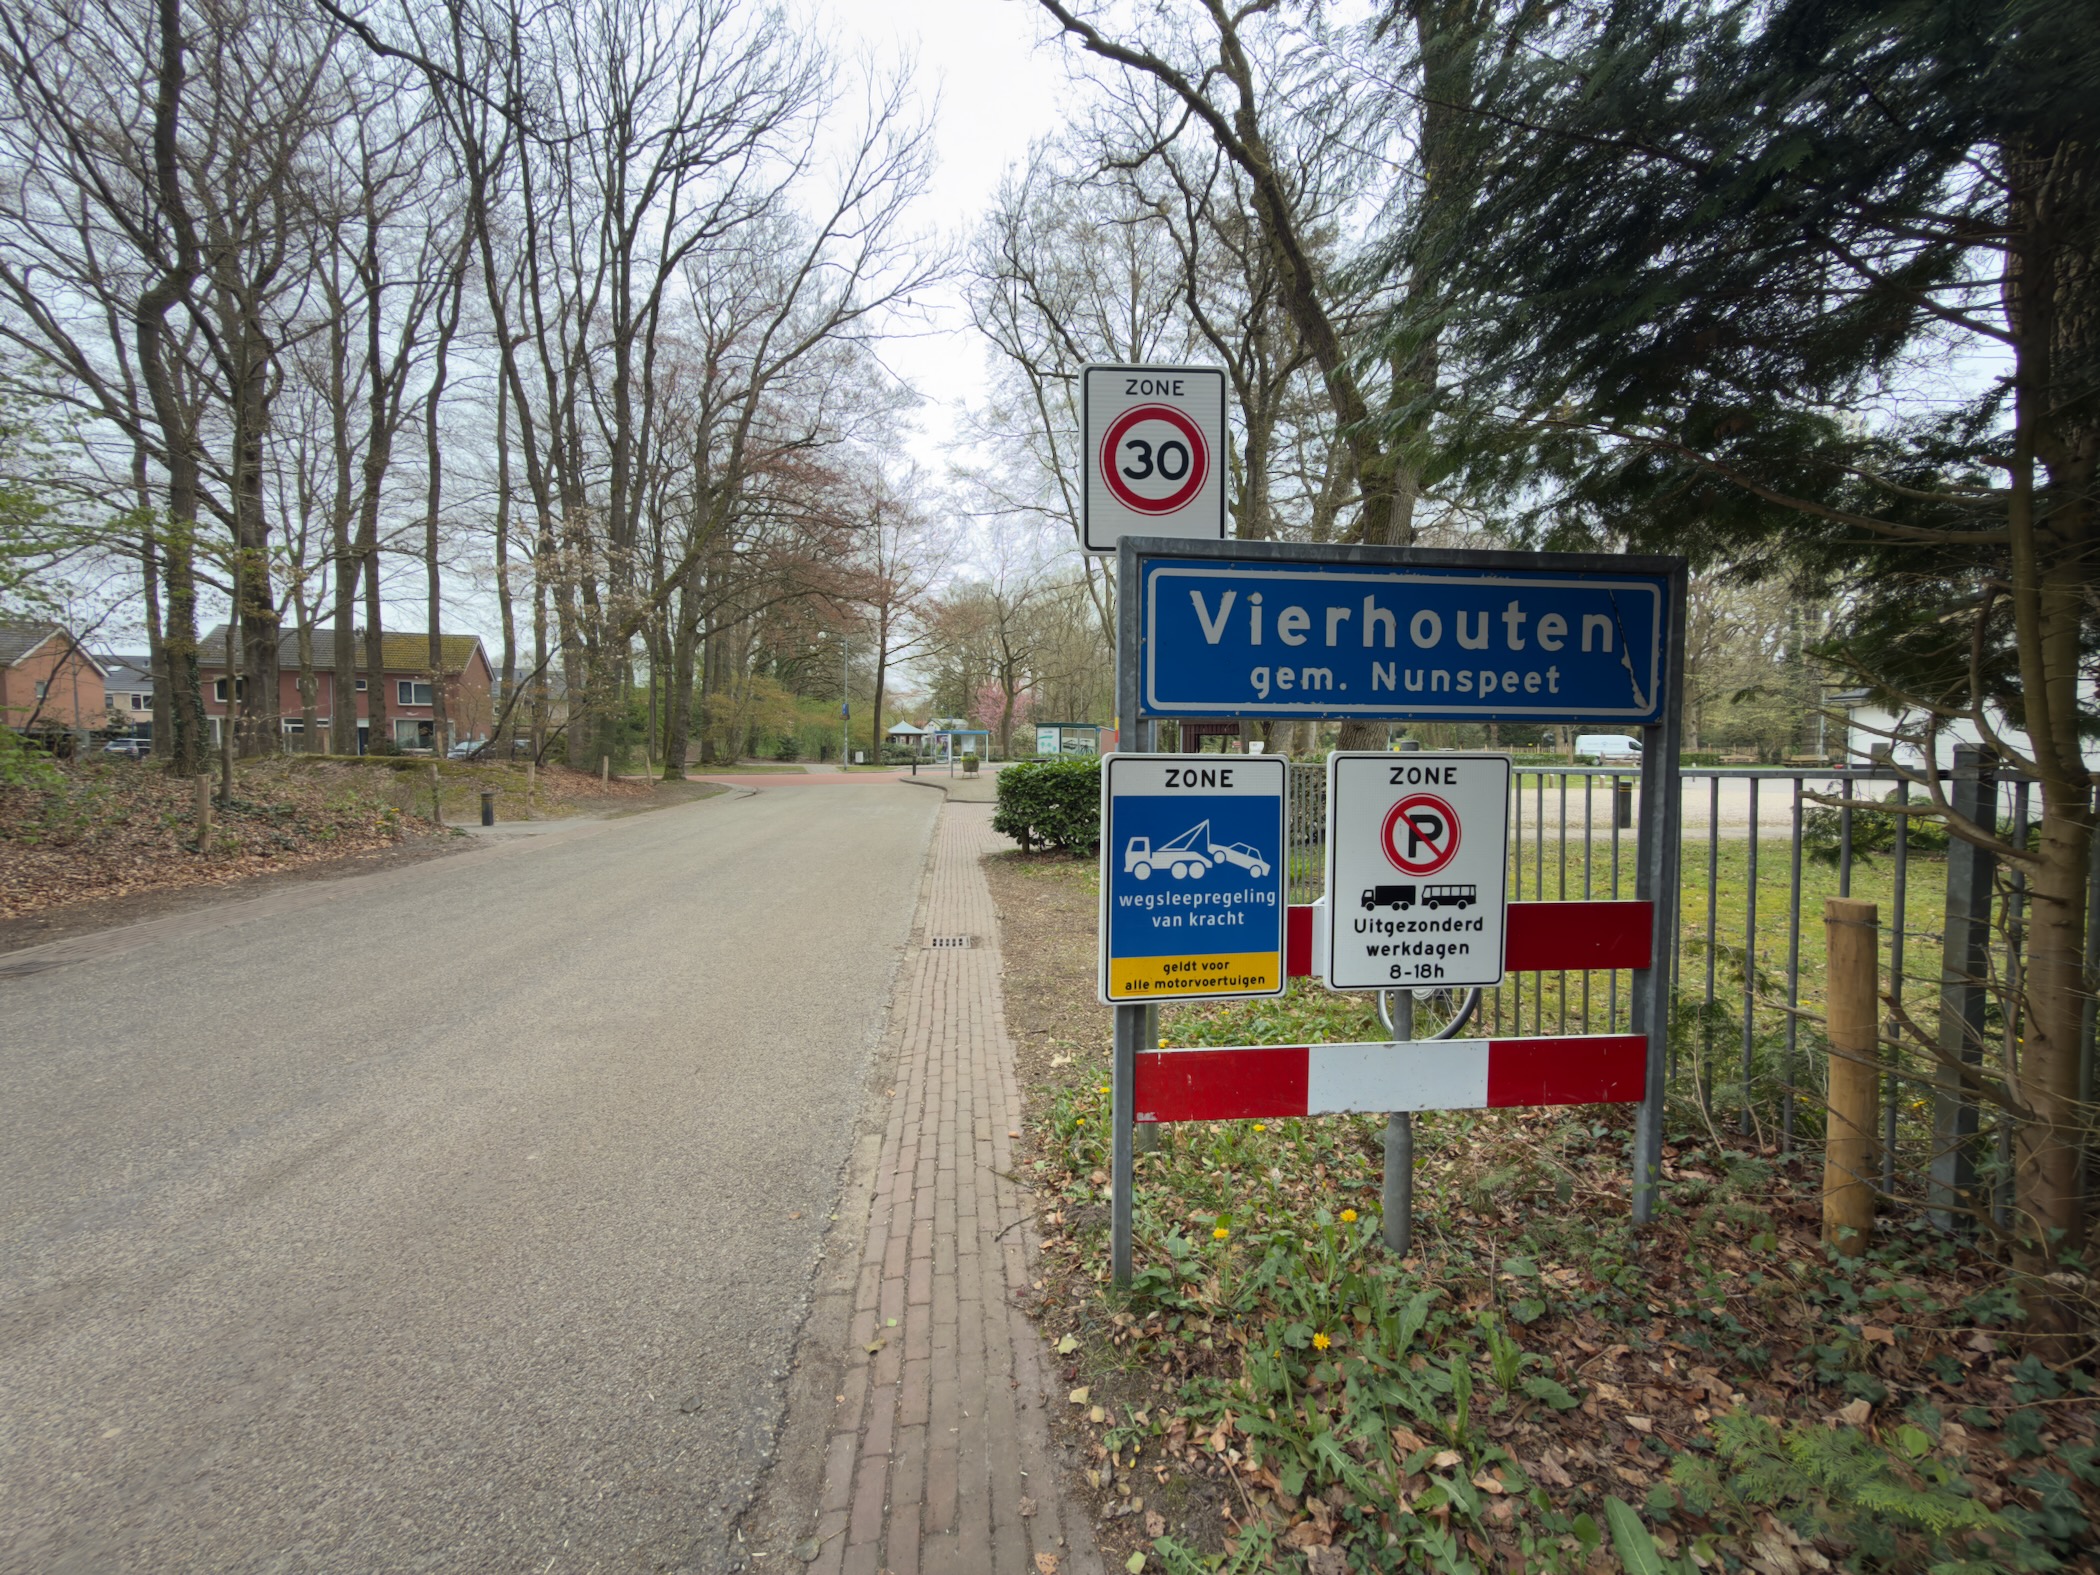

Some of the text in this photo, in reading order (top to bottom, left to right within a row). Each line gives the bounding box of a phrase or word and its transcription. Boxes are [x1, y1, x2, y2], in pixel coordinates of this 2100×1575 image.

[1125, 379, 1185, 397] ZONE
[1122, 439, 1190, 481] 30
[1189, 589, 1613, 653] Vierhouten
[1250, 661, 1560, 700] gem. Nunspeet
[1165, 768, 1234, 788] ZONE
[1389, 766, 1458, 785] ZONE
[1408, 814, 1443, 858] P
[1119, 888, 1276, 911] wegsleepregeling
[1152, 910, 1245, 928] van kracht
[1354, 916, 1484, 938] Uitgezonderd
[1366, 940, 1470, 960] werkdagen
[1163, 960, 1230, 975] geldt voor
[1389, 963, 1444, 980] 8-18h
[1124, 974, 1266, 991] alle motorvoertuigen
